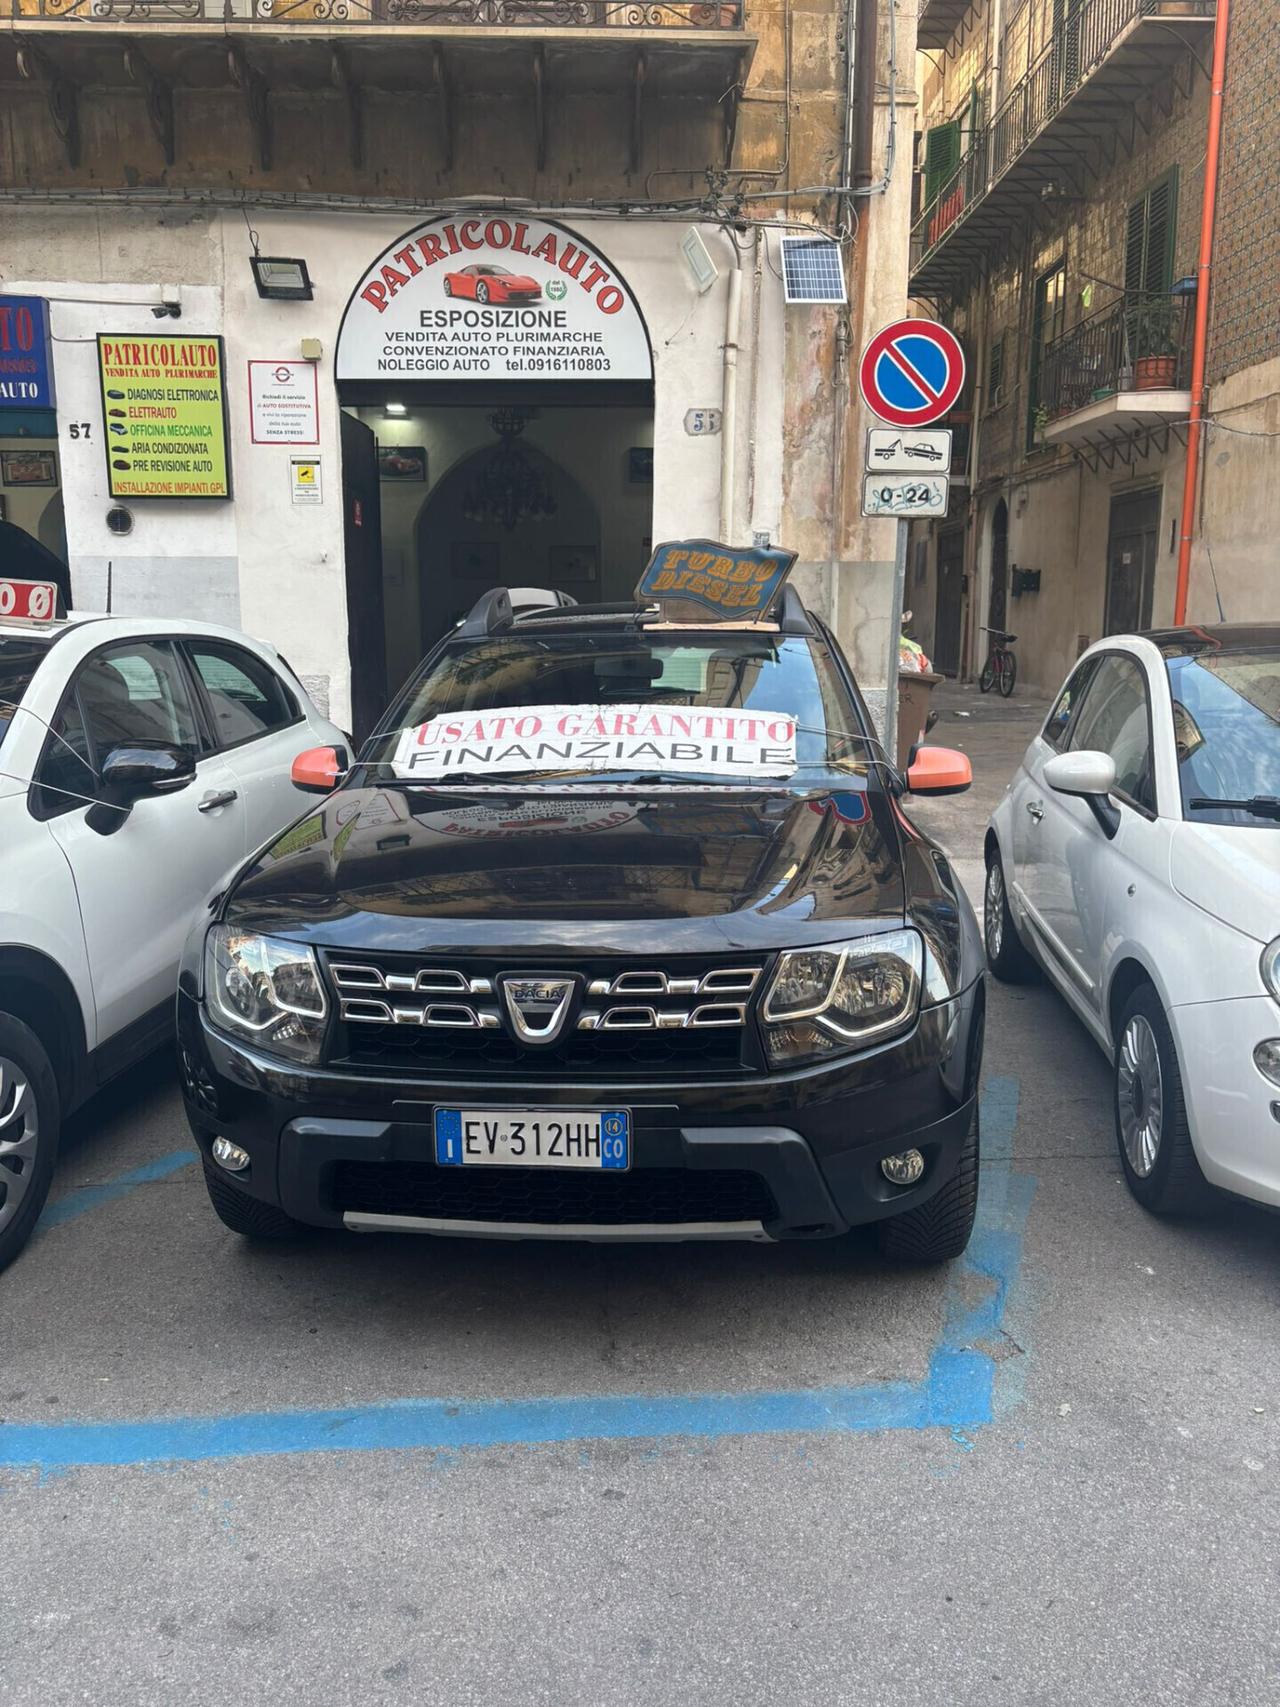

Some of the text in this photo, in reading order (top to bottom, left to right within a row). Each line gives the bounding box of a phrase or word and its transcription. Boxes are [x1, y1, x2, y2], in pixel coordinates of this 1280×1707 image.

[361, 219, 624, 315] PATRICOLAUTO
[420, 310, 567, 328] ESPOSIZIONE
[385, 332, 602, 342] VENDITA AUTO PLURIMARCHE
[103, 343, 217, 367] PATRICOLAUTO
[383, 346, 605, 356] CONVENZIONATO FINANZIARIA
[378, 358, 611, 371] NOLEGGIO AUTO tel.0916110803
[105, 368, 217, 379] VENDITA AUTO PLURIMARCHE
[0, 382, 38, 399] AUTO
[127, 388, 219, 401] DIAGNOSI ELETTRONICA
[128, 407, 177, 419] ELETTRAUTO
[69, 422, 91, 439] 57
[130, 425, 213, 437] OFFICINA MECCANICA
[131, 442, 208, 454] ARIA CONDIZIONATA
[133, 460, 213, 472] PRE REVISIONE AUTO
[113, 482, 226, 494] INSTALLAZIONE IMPIANTI GPL
[663, 550, 778, 582] TURBO
[651, 570, 763, 606] DIESEL
[416, 713, 794, 747] USATO GARANTITO
[408, 741, 793, 770] FINANZIABILE
[514, 989, 562, 999] DACIA
[603, 1139, 624, 1159] CO
